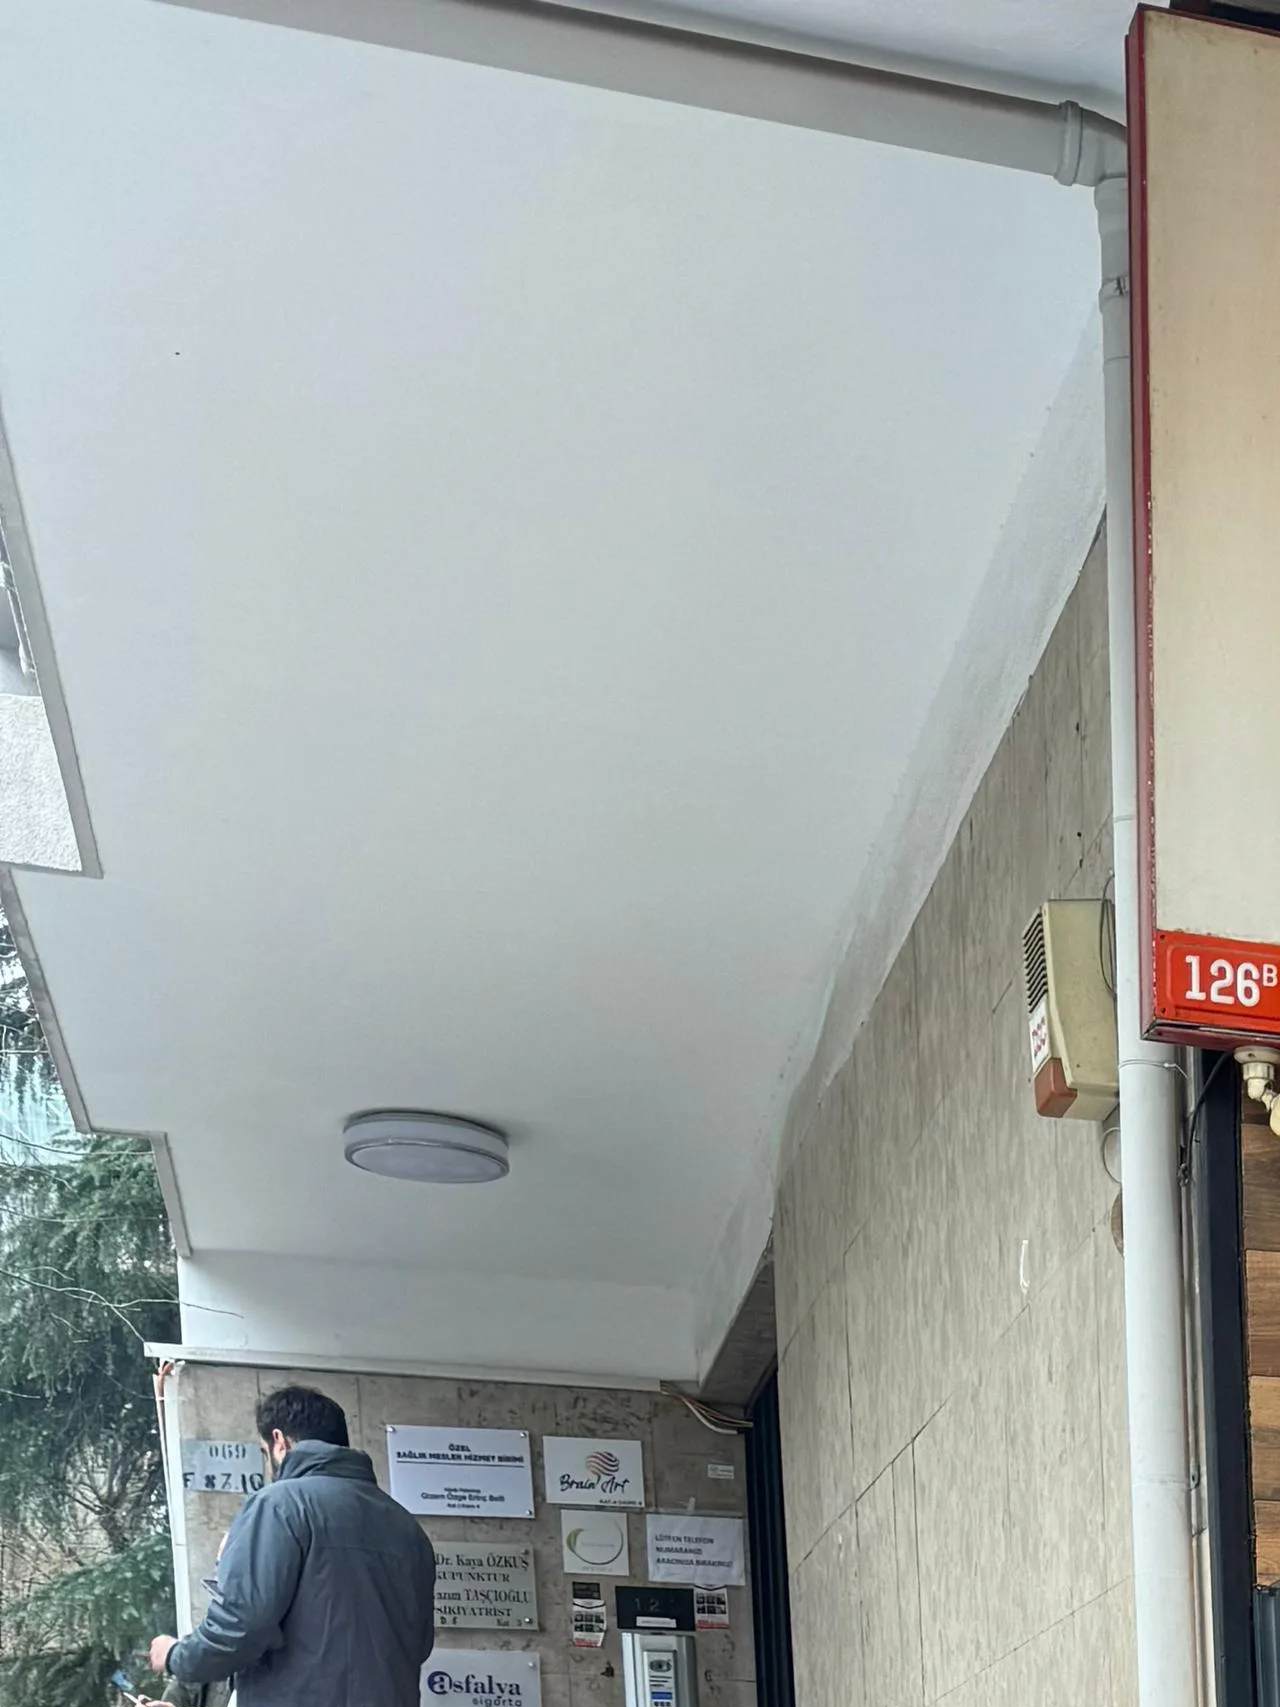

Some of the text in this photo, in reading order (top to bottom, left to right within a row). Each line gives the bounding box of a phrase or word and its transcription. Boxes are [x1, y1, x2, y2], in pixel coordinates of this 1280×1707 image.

[560, 1474, 630, 1494] Brain Art
[456, 1554, 484, 1569] Kaya
[487, 1552, 529, 1572] ÖZKUŞ
